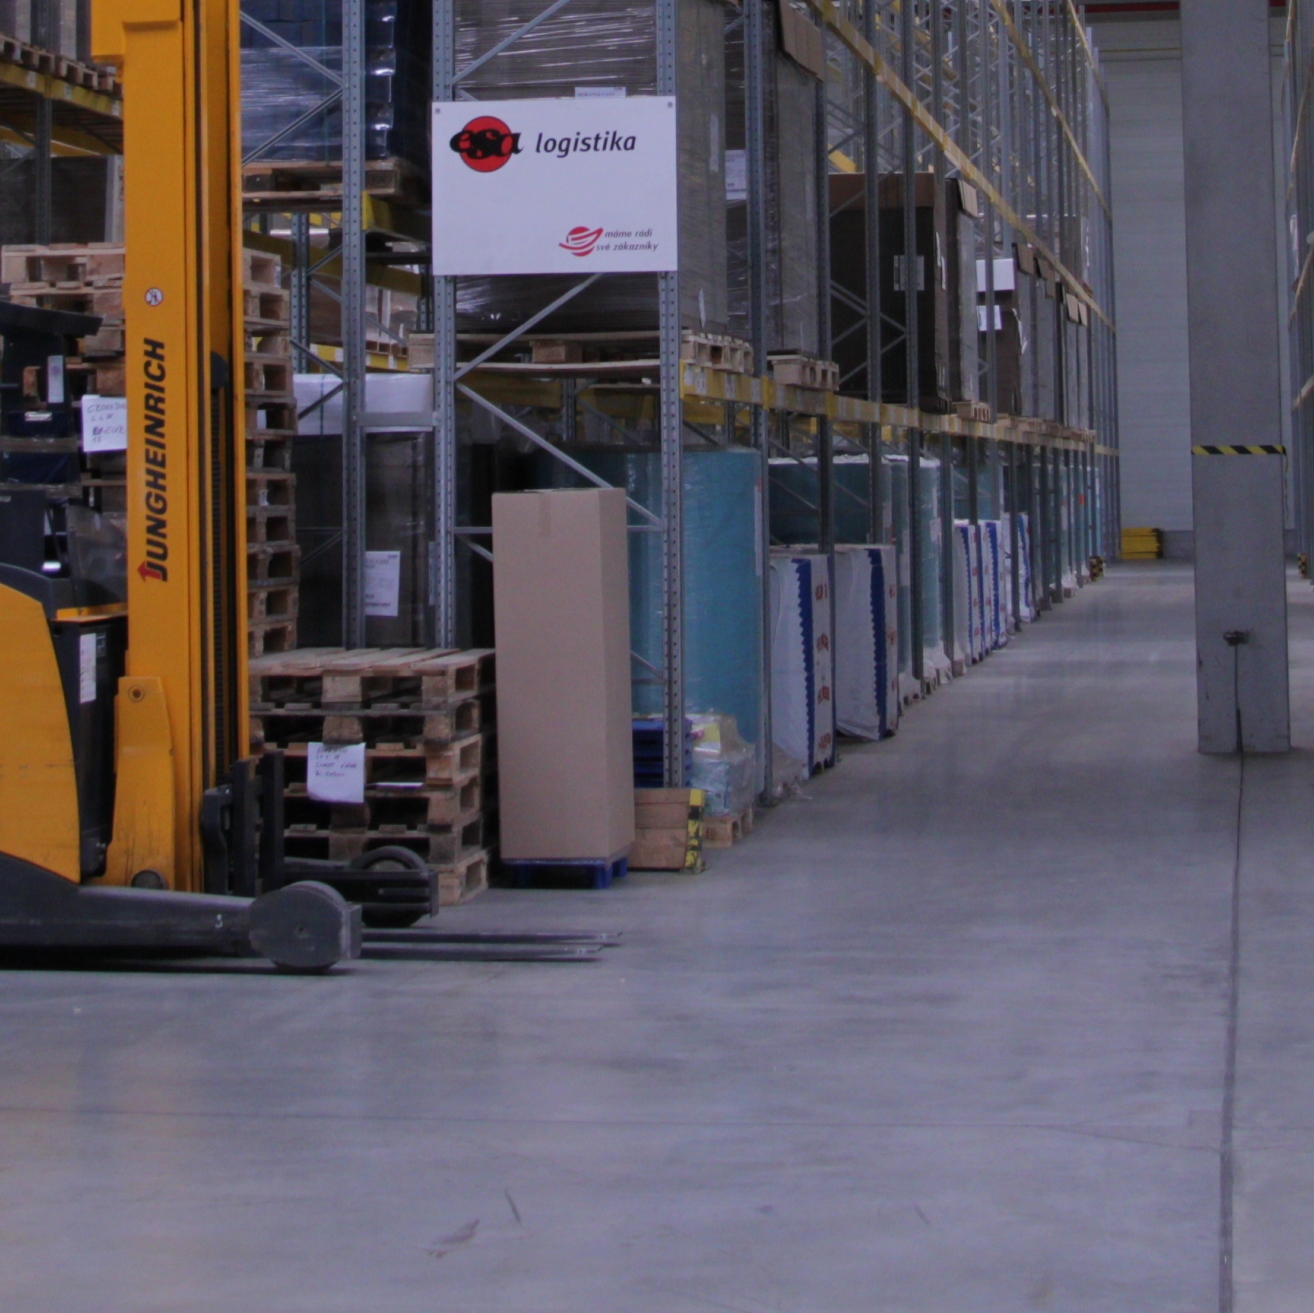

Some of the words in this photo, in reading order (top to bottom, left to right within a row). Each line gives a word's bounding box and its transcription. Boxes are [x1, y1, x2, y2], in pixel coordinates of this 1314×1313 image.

[536, 131, 636, 158] logistika
[604, 229, 631, 238] máme
[635, 228, 653, 237] rádi
[596, 243, 610, 251] své
[613, 241, 659, 252] zákazníky
[139, 338, 169, 582] JUNGHEINRICH
